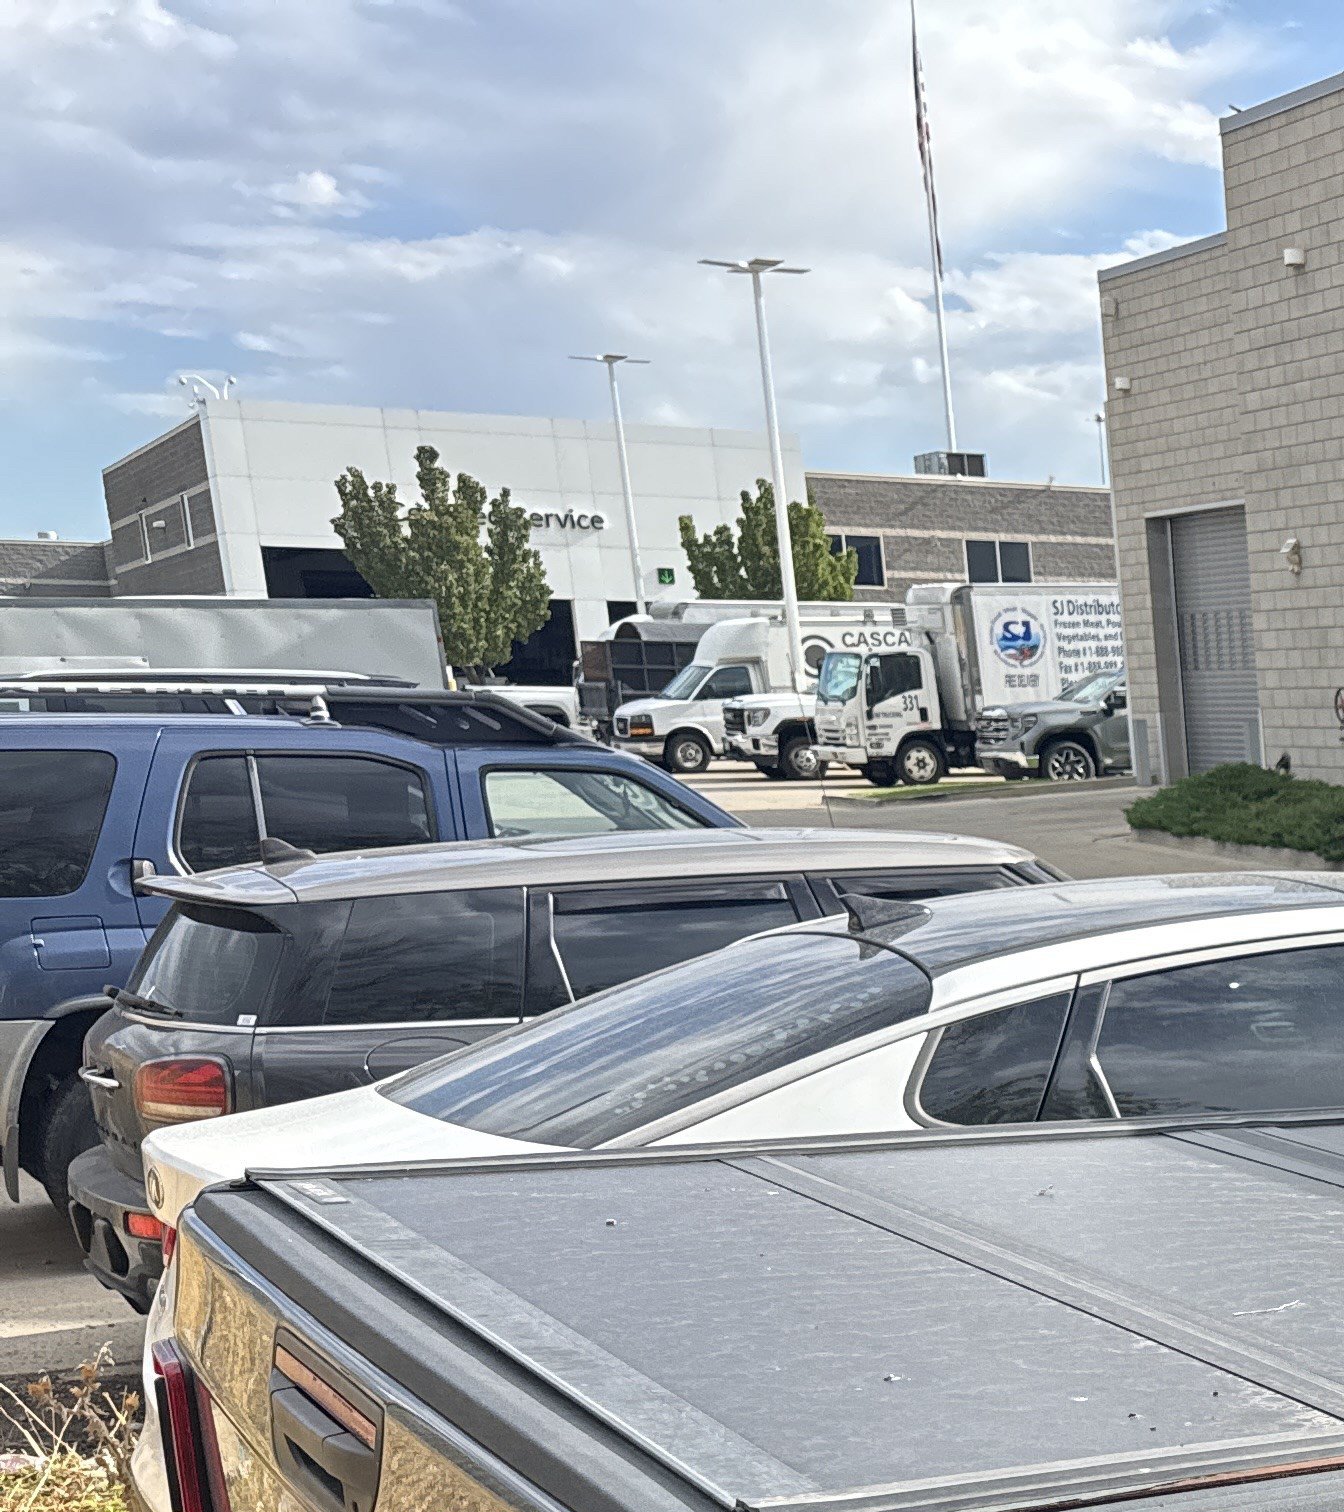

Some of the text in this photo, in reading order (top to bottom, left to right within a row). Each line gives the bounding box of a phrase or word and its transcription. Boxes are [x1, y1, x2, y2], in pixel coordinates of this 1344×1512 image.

[530, 508, 604, 530] ervice
[1052, 599, 1065, 616] SJ
[902, 694, 920, 712] 331
